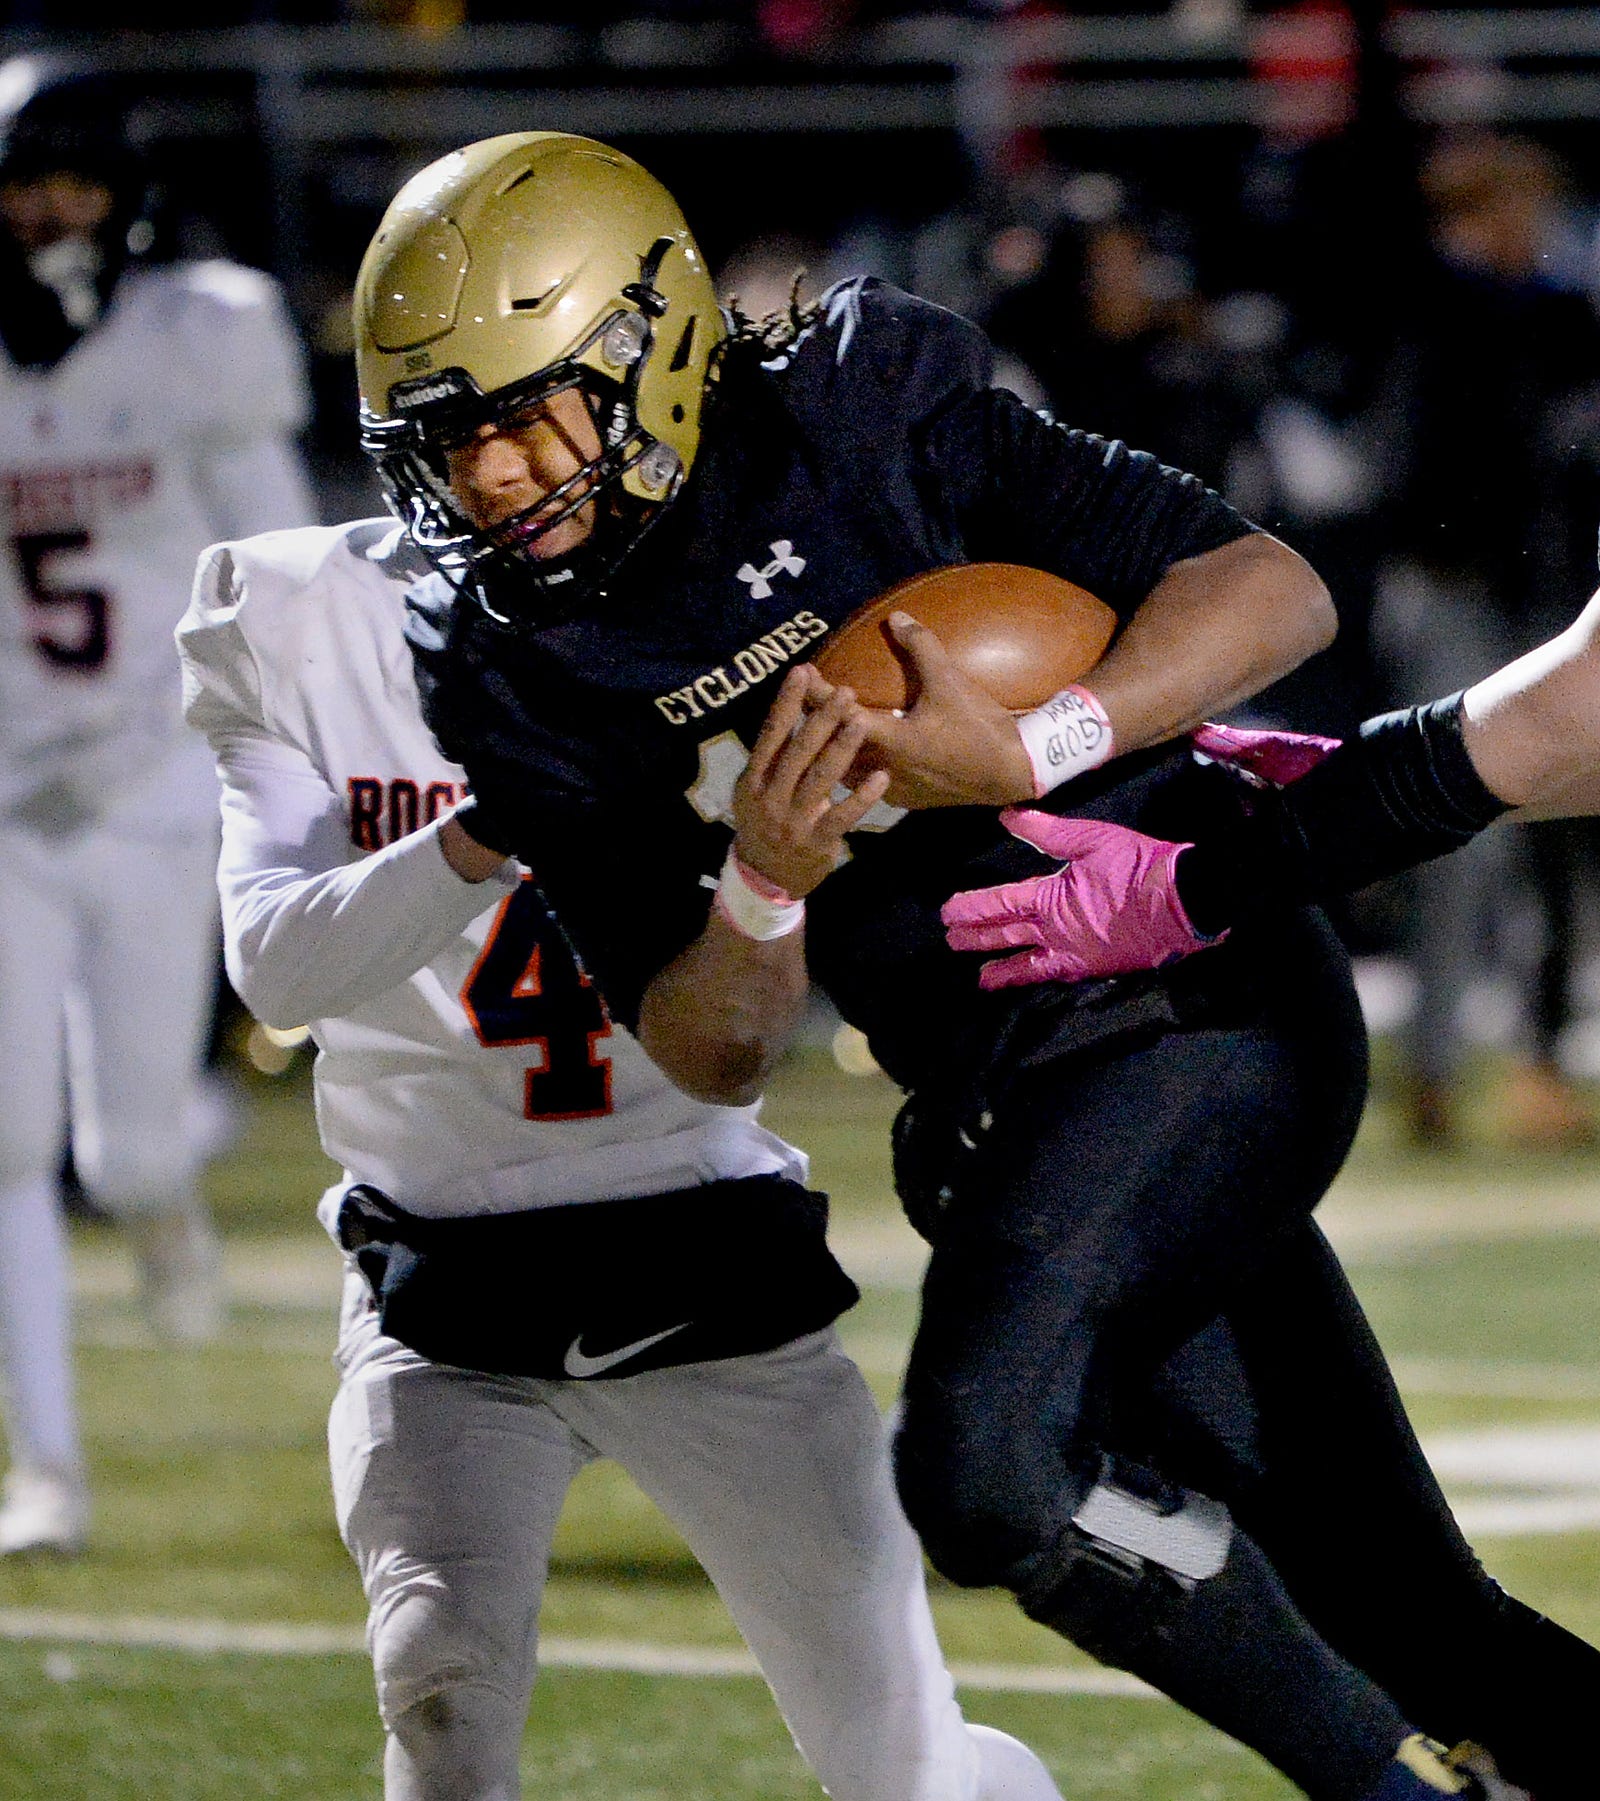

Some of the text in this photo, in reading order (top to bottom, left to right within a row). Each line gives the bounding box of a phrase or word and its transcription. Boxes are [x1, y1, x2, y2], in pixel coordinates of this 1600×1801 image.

[11, 528, 112, 674] 5
[655, 611, 828, 725] CYCLONES
[348, 776, 471, 851] ROC
[459, 872, 613, 1121] 4
